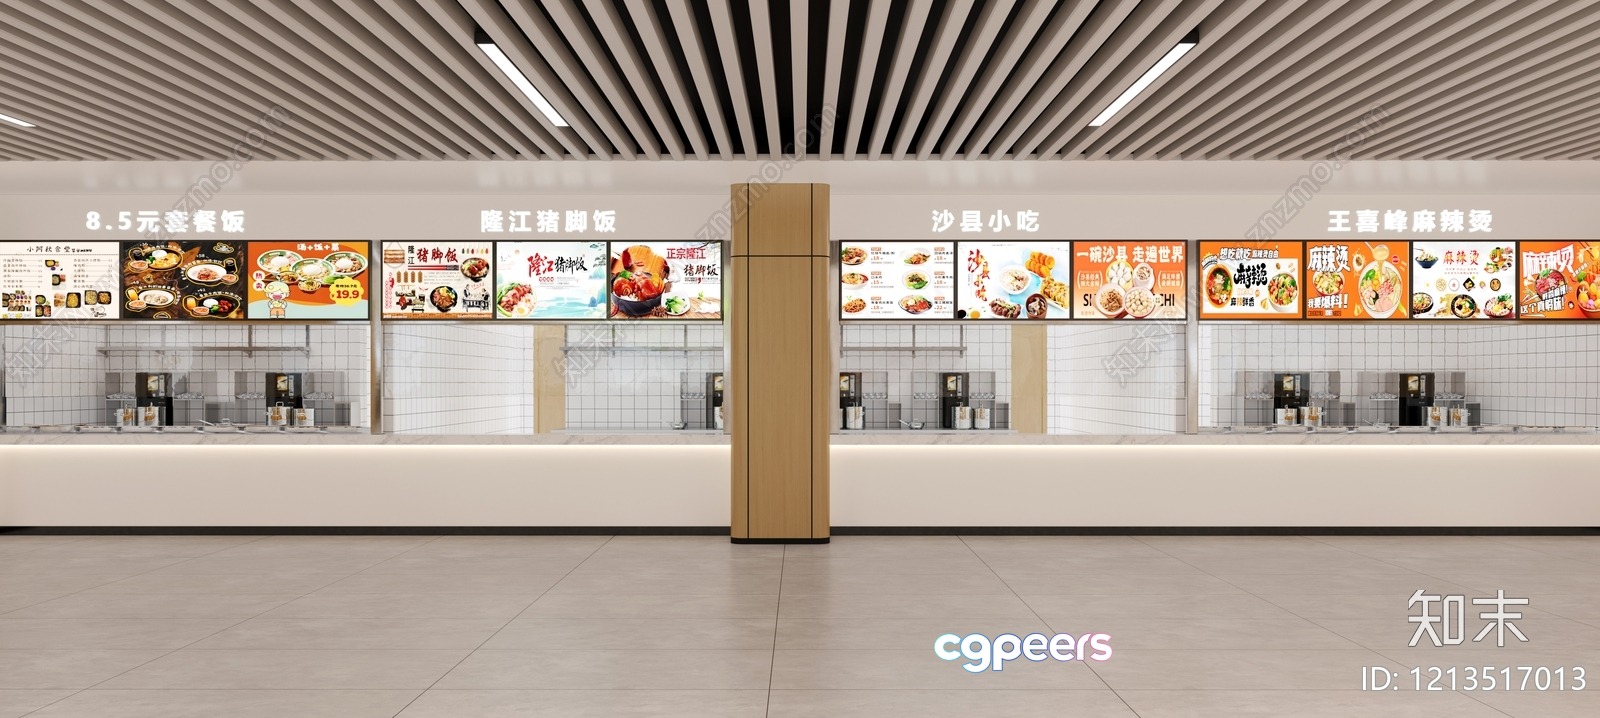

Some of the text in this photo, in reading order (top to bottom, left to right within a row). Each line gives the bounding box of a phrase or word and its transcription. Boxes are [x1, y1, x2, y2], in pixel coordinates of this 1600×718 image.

[85, 209, 246, 233] 8.5元套餐饭
[480, 209, 617, 233] 隆江猪脚饭
[931, 209, 1040, 233] 沙县小吃
[1327, 209, 1493, 233] 王喜峰麻辣烫
[416, 247, 458, 264] 猪脚饭
[666, 247, 706, 260] 正宗隆江
[1076, 245, 1128, 263] 一碗沙县
[1132, 245, 1184, 263] 走遍世界
[1307, 244, 1351, 273] 麻辣烫
[1443, 250, 1480, 266] 麻辣烫
[683, 263, 719, 277] 猪脚饭
